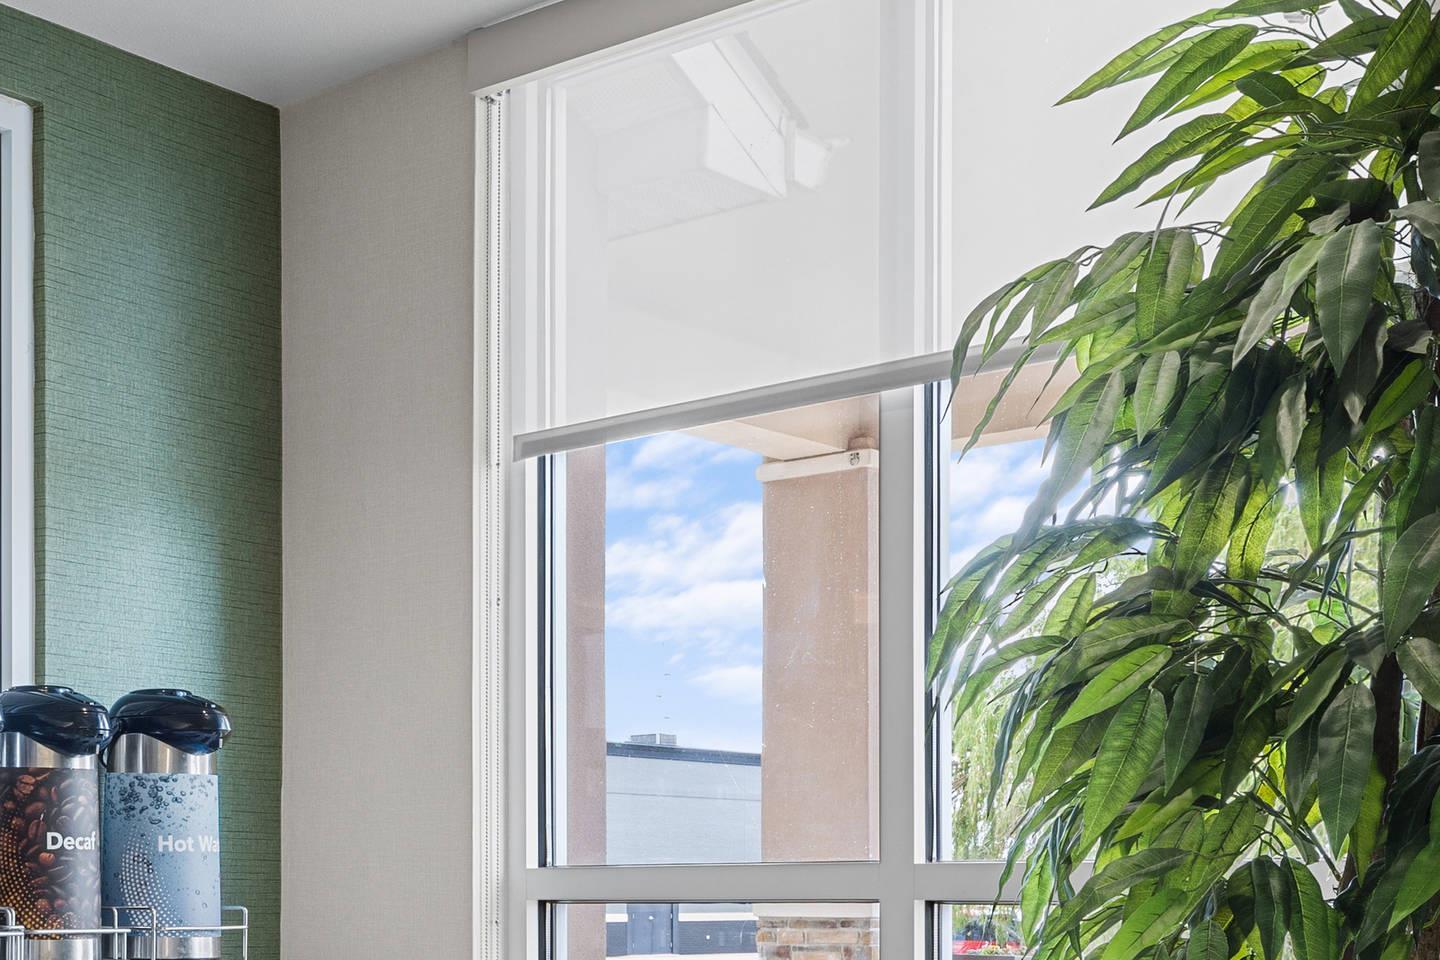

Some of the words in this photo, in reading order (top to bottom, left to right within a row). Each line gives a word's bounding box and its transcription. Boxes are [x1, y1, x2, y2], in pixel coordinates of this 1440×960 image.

[47, 831, 96, 850] Decaf
[158, 835, 194, 852] Hot
[198, 835, 219, 852] Wa
